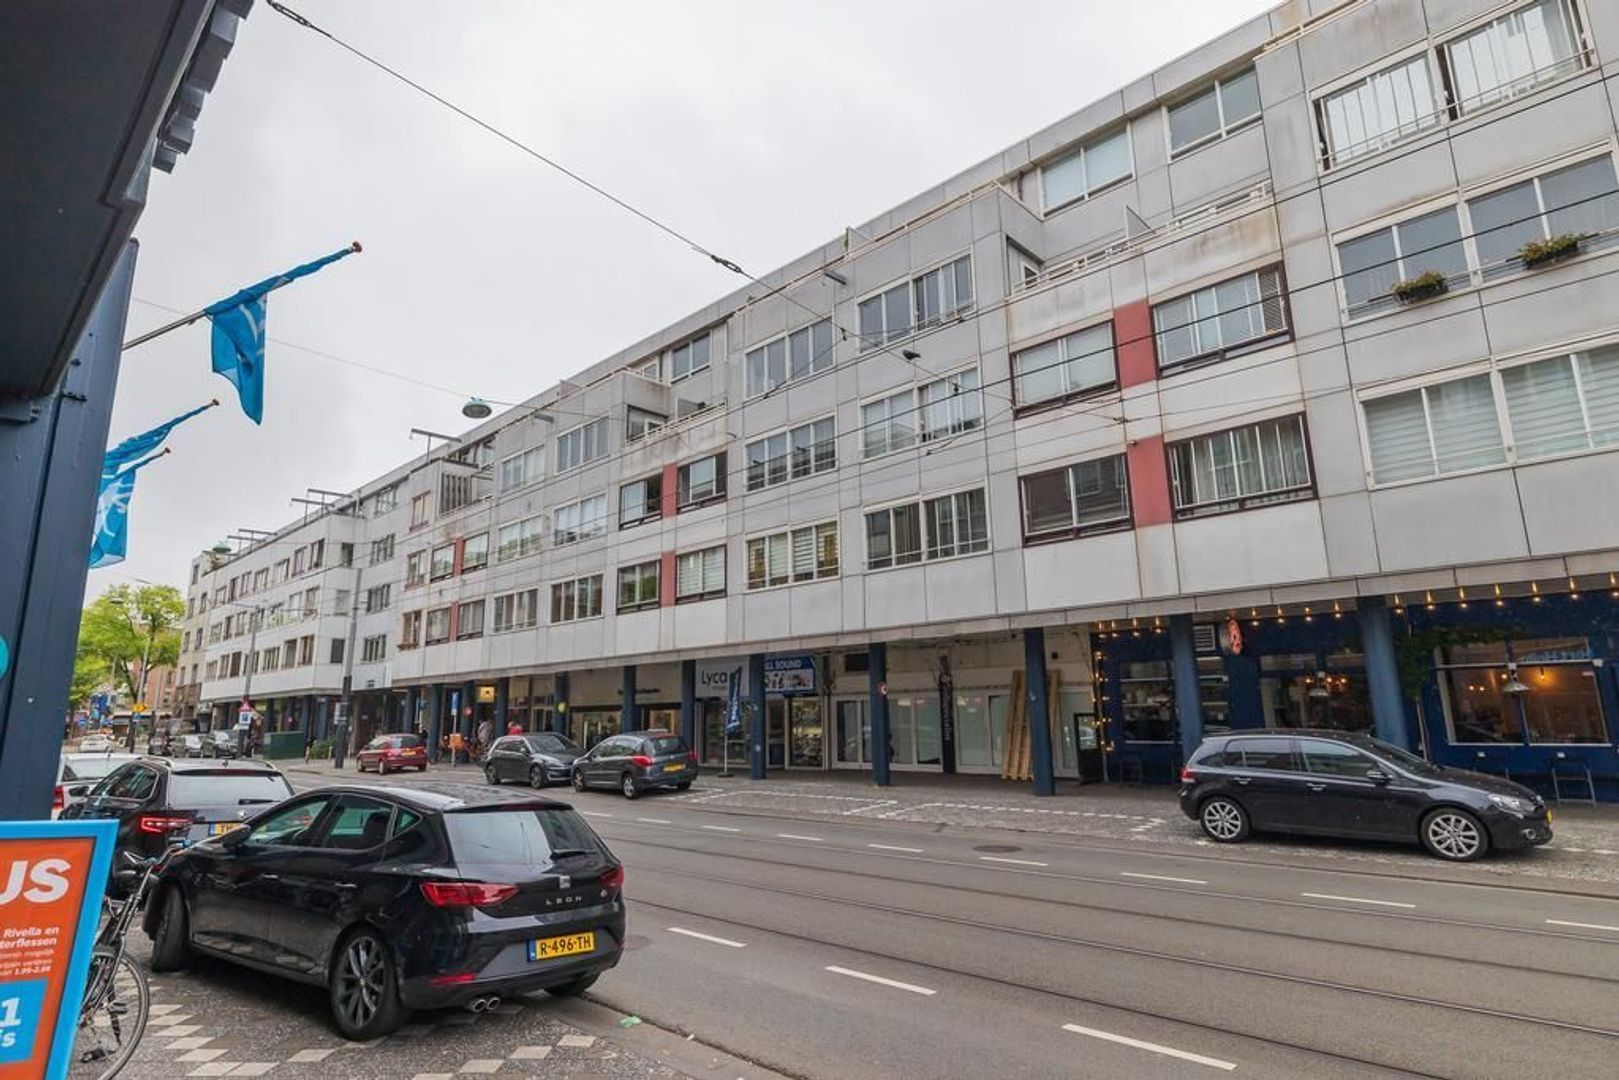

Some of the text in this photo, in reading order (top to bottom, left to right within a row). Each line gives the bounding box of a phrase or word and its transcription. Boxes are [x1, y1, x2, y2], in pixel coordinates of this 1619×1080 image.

[701, 670, 728, 687] Lyca
[545, 896, 582, 905] LEON
[3, 926, 60, 938] Rivella en
[540, 935, 591, 956] R-496-TH
